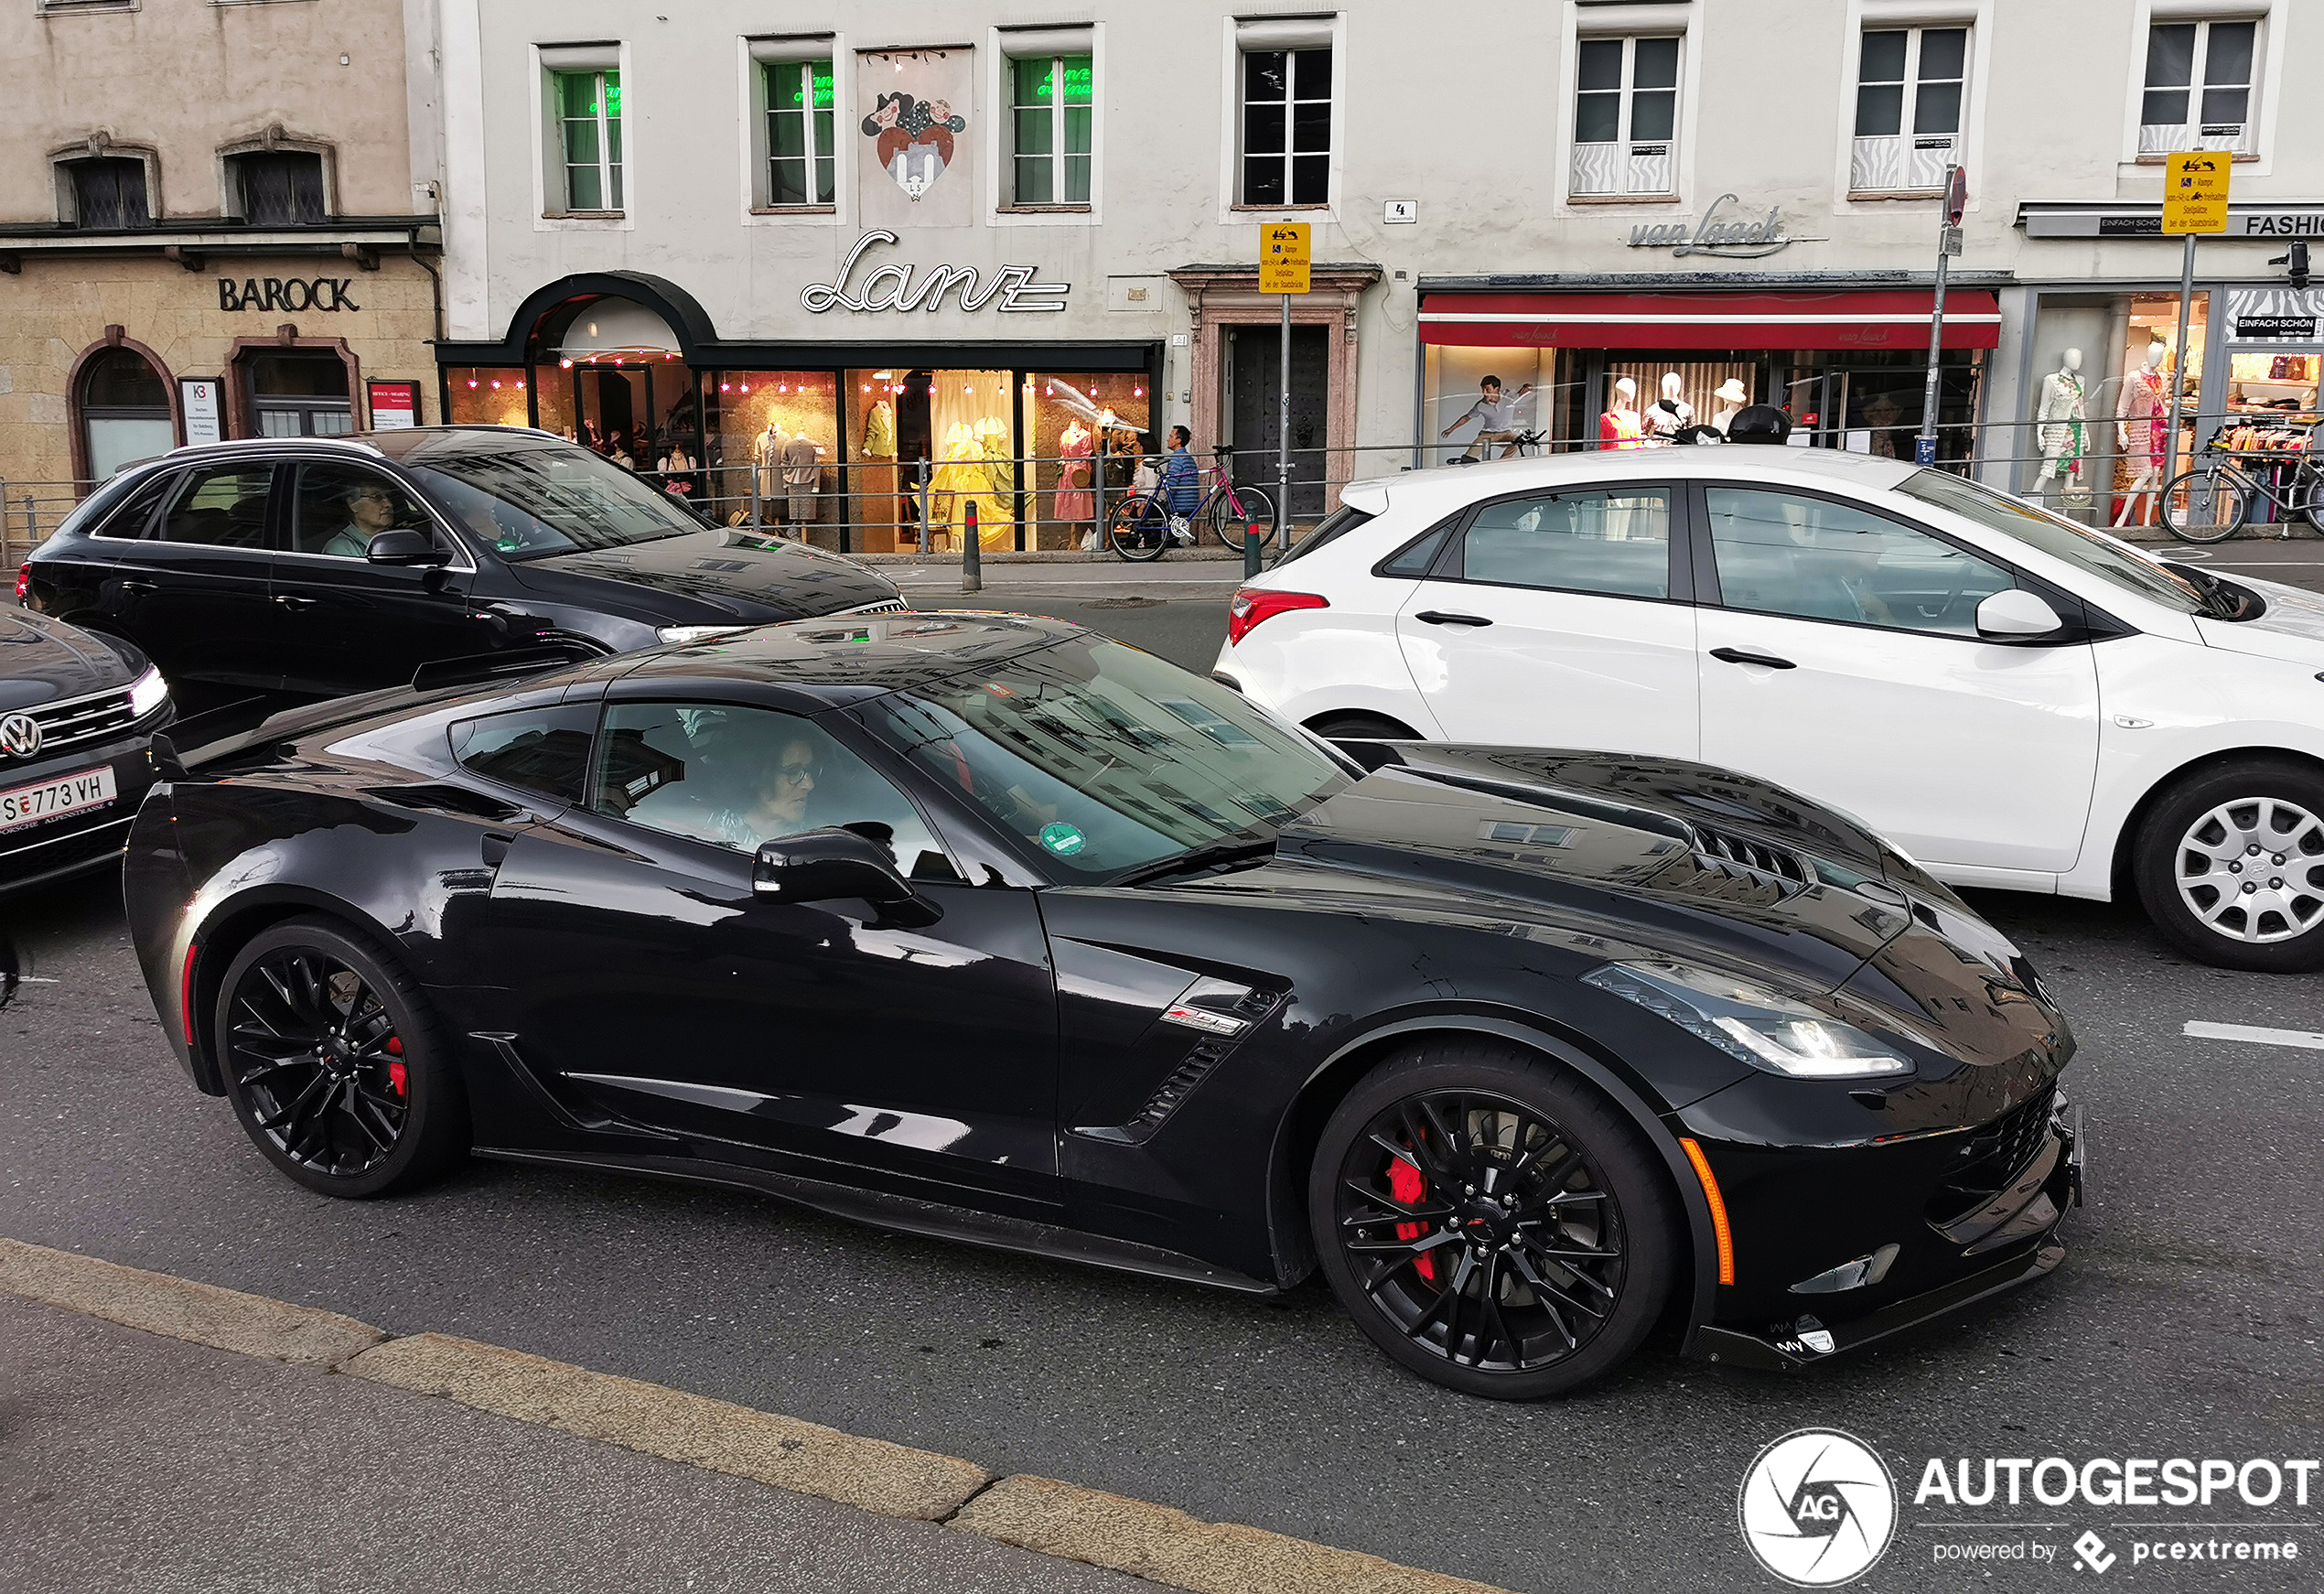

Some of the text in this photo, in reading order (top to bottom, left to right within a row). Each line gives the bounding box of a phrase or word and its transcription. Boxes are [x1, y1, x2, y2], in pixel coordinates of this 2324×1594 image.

[1396, 204, 1404, 215] 4
[2102, 219, 2135, 227] EINFACH
[1628, 193, 1791, 259] van Laack
[799, 228, 1072, 313] Lanz
[218, 277, 360, 312] BAROCK
[2239, 319, 2278, 328] EINFACH
[2280, 318, 2313, 327] SCHÖN
[193, 385, 206, 398] K3
[4, 776, 102, 820] S 773 VH
[0, 803, 105, 835] ORSCHE ALPENSTRASSE
